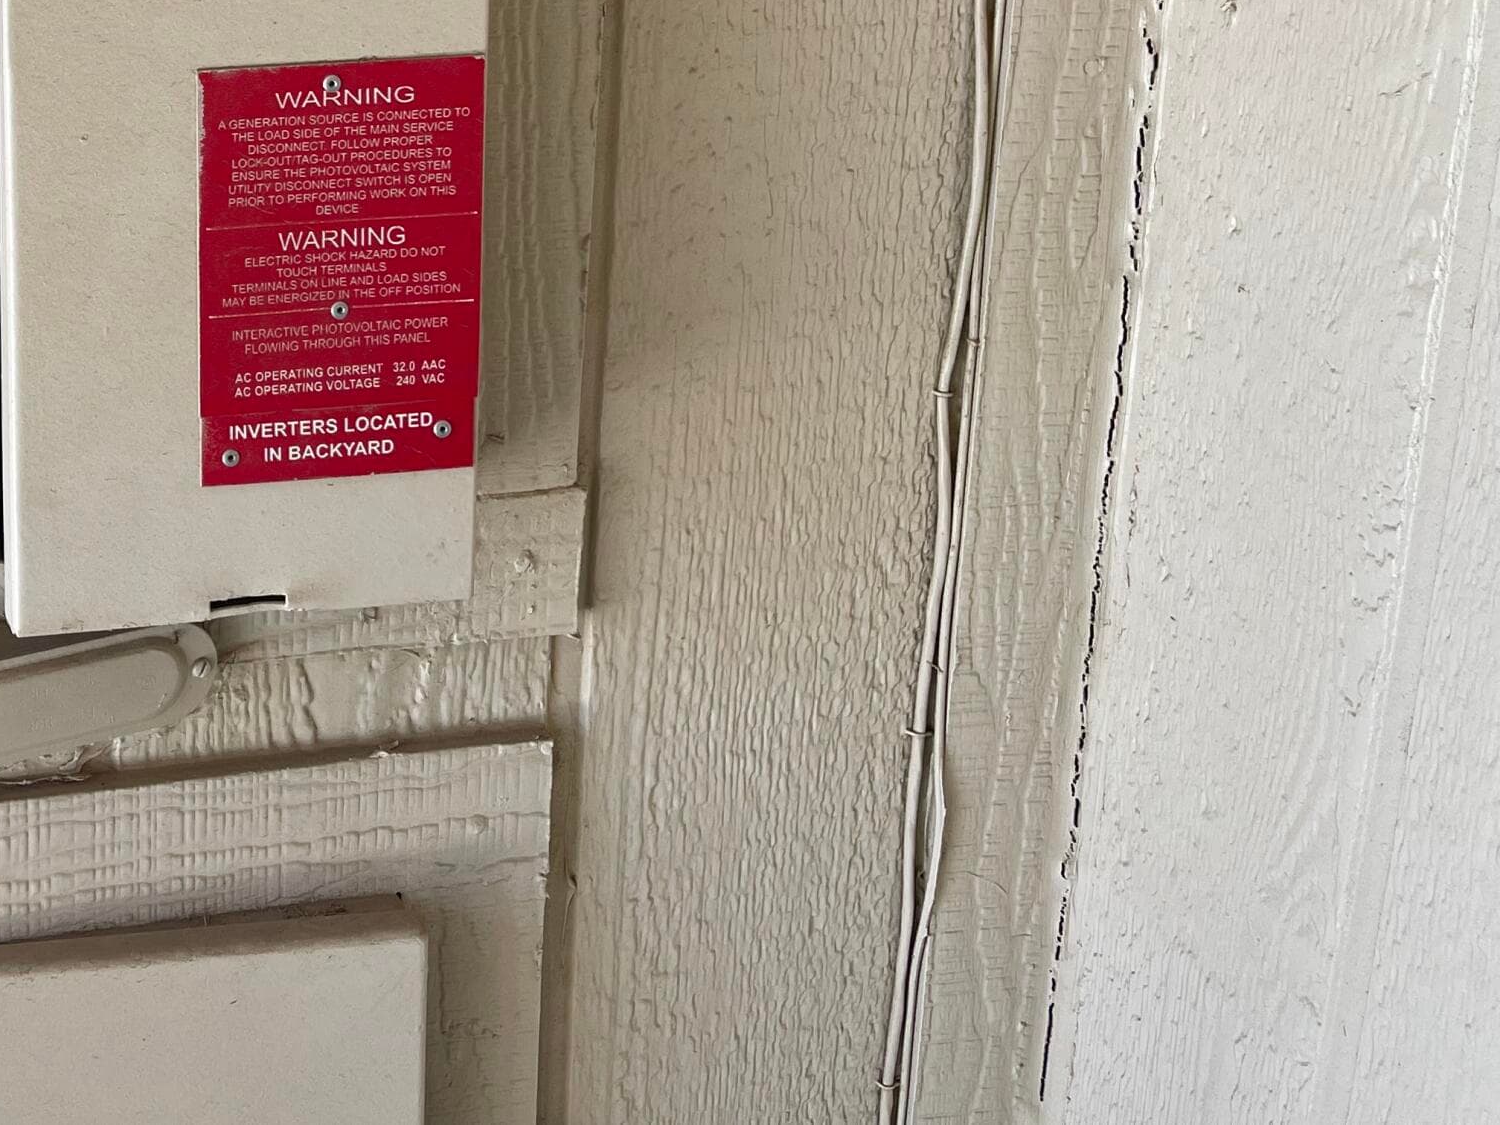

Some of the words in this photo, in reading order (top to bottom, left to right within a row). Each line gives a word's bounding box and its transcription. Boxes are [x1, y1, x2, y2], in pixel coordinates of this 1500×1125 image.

[275, 85, 415, 109] WARNING
[218, 120, 227, 130] A
[228, 115, 306, 130] GENERATION
[308, 112, 360, 125] SOURCE
[363, 112, 374, 122] IS
[376, 108, 452, 122] CONNECTED
[454, 106, 471, 117] TO
[231, 131, 255, 143] THE
[258, 130, 290, 141] LOAD
[292, 128, 321, 139] SIDE
[323, 126, 340, 138] OF
[343, 125, 367, 136] THE
[369, 124, 400, 135] MAIN
[402, 121, 454, 133] SERVICE
[330, 138, 380, 150] FOLLOW
[383, 135, 433, 147] PROPER
[350, 148, 434, 162] PROCEDURES
[436, 146, 452, 157] TO
[231, 169, 280, 182] ENSURE
[283, 167, 307, 178] THE
[309, 162, 400, 177] PHOTOVOLTAIC
[403, 160, 452, 172] SYSTEM
[228, 183, 272, 195] UTILITY
[274, 178, 352, 192] DISCONNECT
[355, 175, 401, 188] SWITCH
[404, 174, 416, 185] IS
[418, 173, 452, 184] OPEN
[228, 196, 265, 208] PRIOR
[268, 195, 285, 206] TO
[287, 190, 367, 204] PERFORMING
[369, 188, 407, 199] WORK
[409, 186, 427, 197] ON
[430, 185, 457, 196] THIS
[315, 203, 359, 215] DEVICE
[278, 225, 406, 252] WARNING
[244, 253, 302, 268] ELECTRIC
[305, 251, 347, 264] SHOCK
[349, 248, 397, 260] HAZARD
[400, 247, 419, 258] DO
[421, 245, 446, 257] NOT
[276, 266, 318, 278] TOUCH
[320, 261, 388, 275] TERMINALS
[232, 280, 297, 294] TERMINALS
[300, 278, 318, 290] ON
[321, 276, 347, 288] LINE
[349, 275, 374, 286] AND
[377, 273, 409, 285] LOAD
[412, 270, 447, 282] SIDES
[222, 296, 247, 308] MAY
[249, 295, 265, 306] BE
[267, 290, 336, 305] ENERGIZED
[338, 290, 350, 300] IN
[354, 287, 376, 298] THE
[378, 286, 402, 297] OFF
[405, 283, 461, 296] POSITION
[232, 325, 309, 341] INTERACTIVE
[312, 319, 401, 335] PHOTOVOLTAIC
[404, 316, 449, 329] POWER
[244, 340, 299, 355] FLOWING
[302, 336, 361, 350] THROUGH
[364, 334, 390, 346] THIS
[393, 332, 431, 344] PANEL
[235, 373, 252, 384] AC
[255, 366, 324, 383] OPERATING
[326, 362, 384, 377] CURRENT
[392, 360, 416, 373] 32.0
[421, 358, 446, 371] AAC
[234, 386, 251, 398] AC
[254, 381, 323, 397] OPERATING
[325, 377, 381, 391] VOLTAGE
[396, 375, 416, 386] 240
[421, 372, 445, 384] VAC
[229, 418, 338, 441] INVERTERS
[344, 411, 433, 433] LOCATED
[264, 446, 282, 462] IN
[288, 439, 395, 461] BACKYARD
